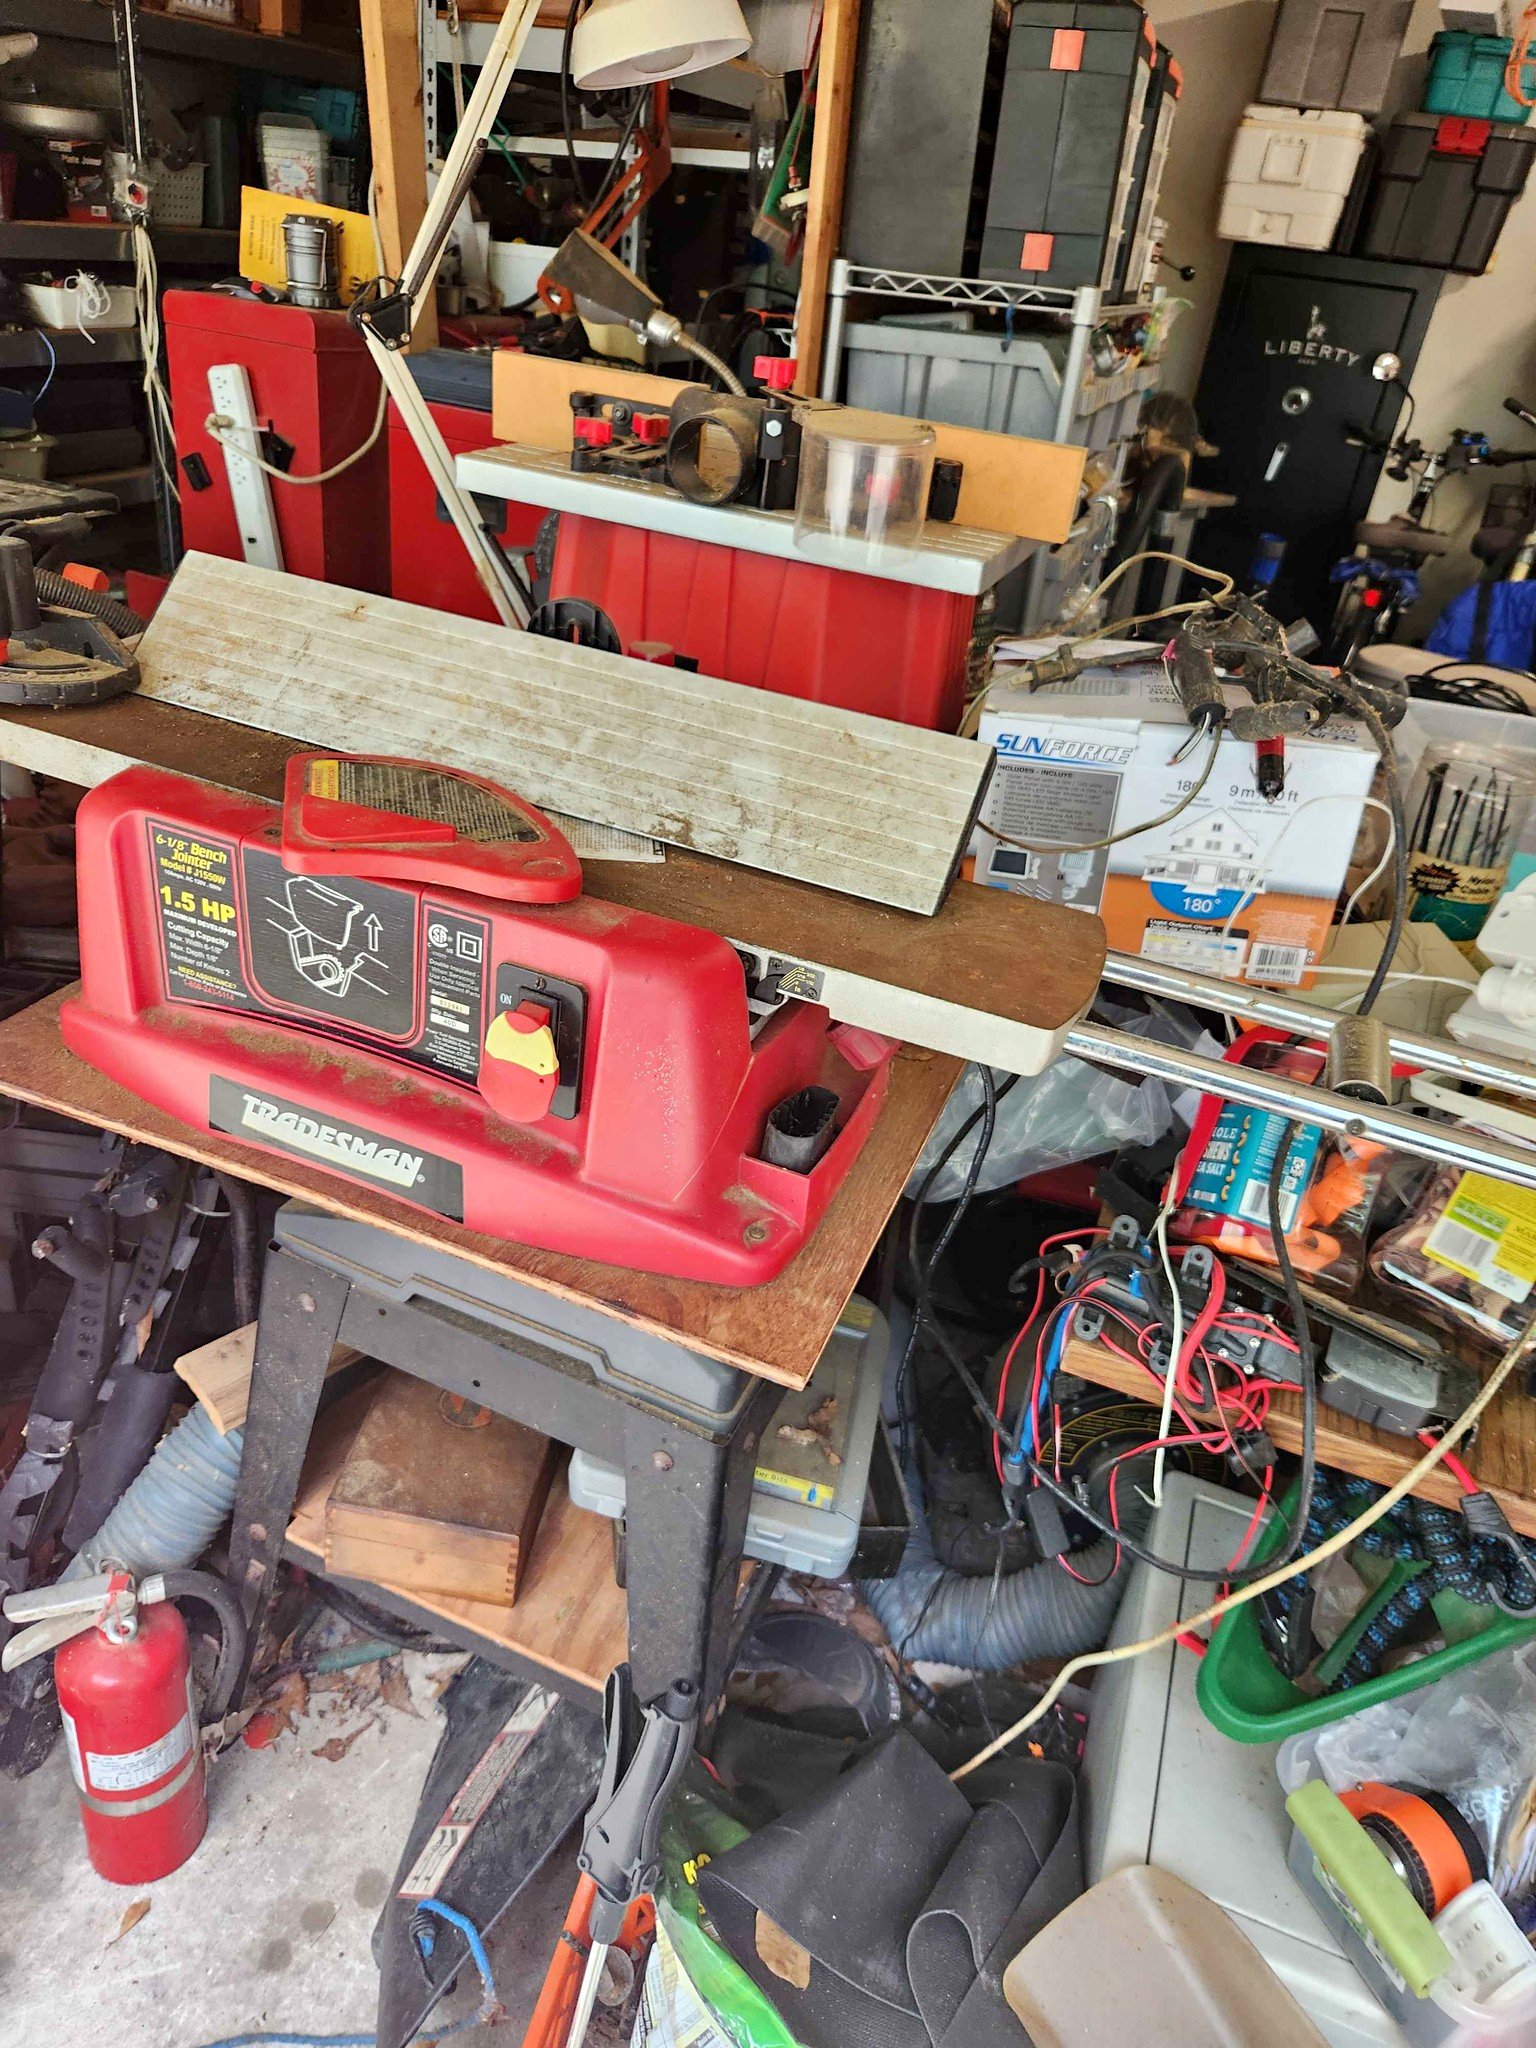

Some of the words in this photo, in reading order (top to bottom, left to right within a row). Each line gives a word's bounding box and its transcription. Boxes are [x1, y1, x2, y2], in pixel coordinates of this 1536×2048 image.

[1264, 340, 1360, 366] LIBERTY
[996, 733, 1133, 765] SUNFORCE
[1229, 785, 1239, 797] 9
[1240, 788, 1254, 798] m
[1287, 790, 1299, 802] ft
[160, 857, 186, 873] Model
[171, 848, 213, 870] Jointer
[191, 842, 227, 864] Bench
[160, 885, 196, 912] 1.5
[202, 897, 236, 924] HP
[1183, 897, 1222, 914] 180°
[163, 908, 197, 924] MAXIMUM
[197, 919, 237, 938] DEVELOPED
[167, 921, 195, 938] Cutting
[195, 930, 229, 949] Capacity
[500, 993, 513, 1005] ON
[241, 1093, 424, 1188] TRADESMAN
